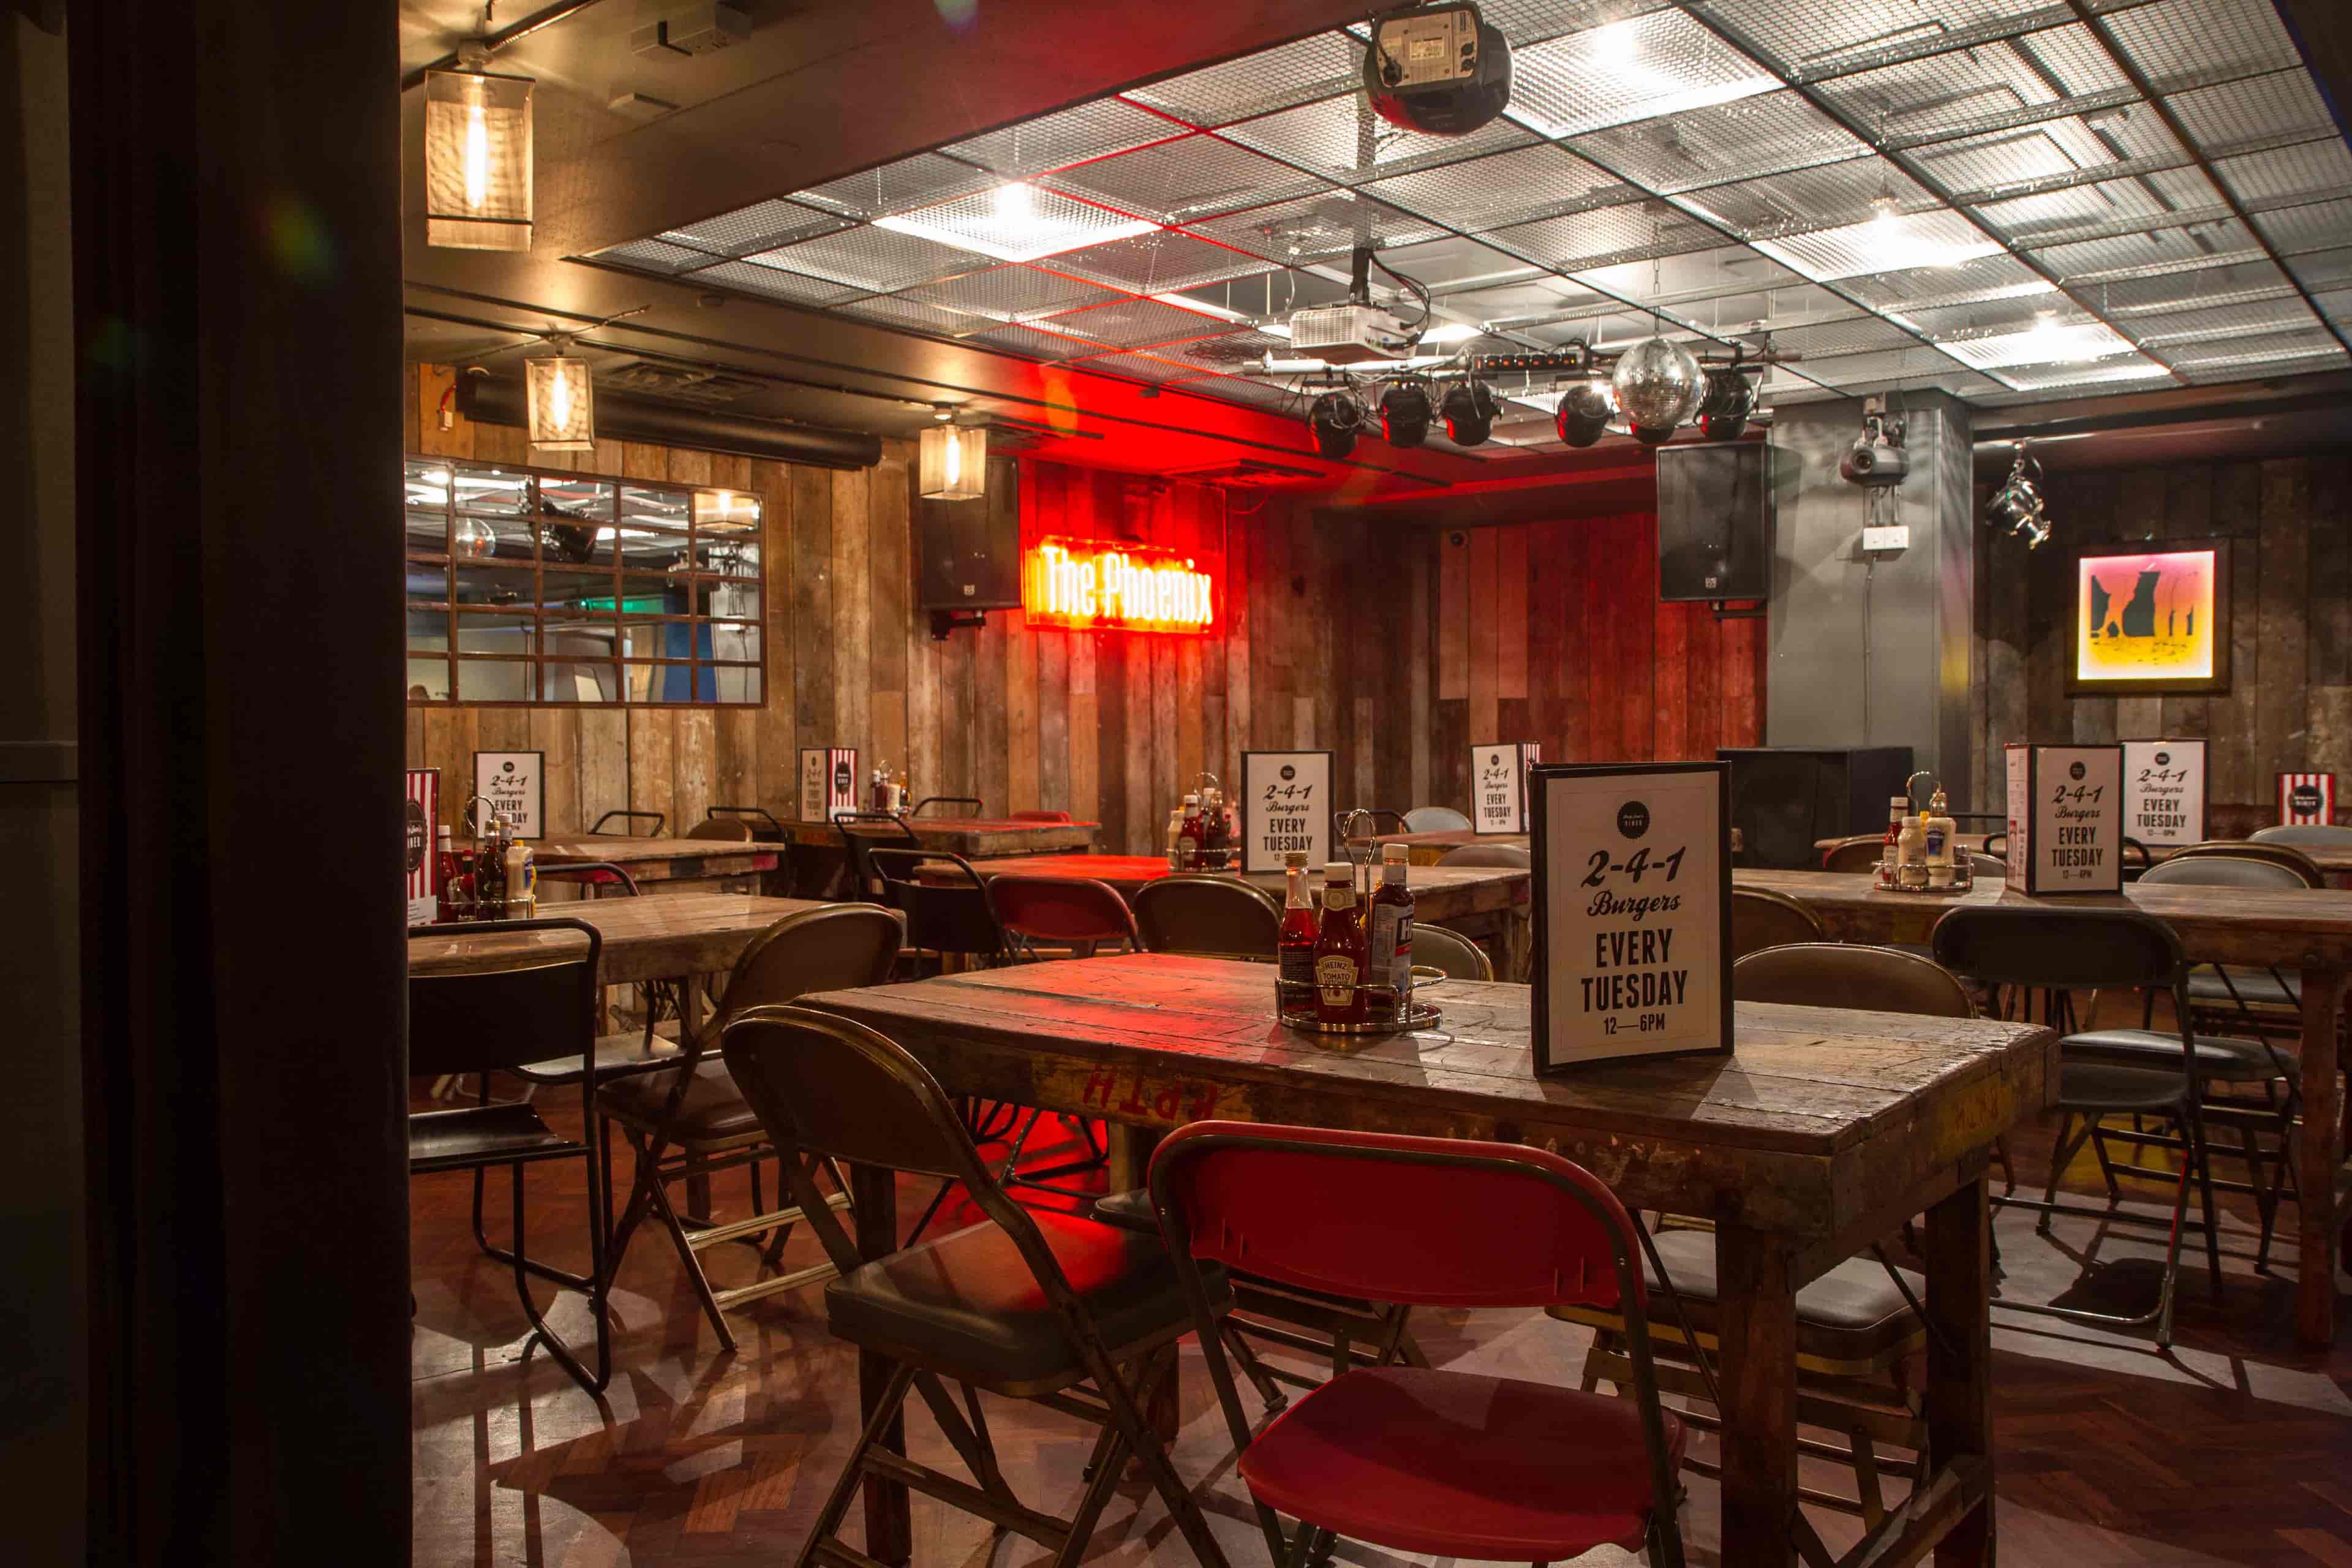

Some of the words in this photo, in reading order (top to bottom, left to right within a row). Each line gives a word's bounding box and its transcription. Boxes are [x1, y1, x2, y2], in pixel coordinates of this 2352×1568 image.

[1041, 545, 1095, 616] The
[1102, 552, 1213, 625] Phoenix
[490, 775, 528, 785] 2-4-1
[1483, 768, 1509, 780] 2-4-1
[2136, 769, 2188, 782] 2-4-1
[1263, 784, 1313, 799] 2-4-1
[2052, 785, 2104, 804] 2-4-1
[495, 800, 522, 810] EVERY
[1487, 794, 1506, 805] EVERY
[2144, 799, 2180, 812] EVERY
[1266, 801, 1310, 815] Burgers
[1483, 807, 1511, 818] TUESDAY
[2054, 805, 2101, 823] Burgers
[1270, 818, 1306, 833] EVERY
[2136, 814, 2187, 827] TUESDAY
[1264, 835, 1313, 851] TUESDAY
[2059, 826, 2097, 845] EVERY
[2052, 848, 2103, 867] TUESDAY
[1581, 846, 1686, 888] 2-4-1
[1587, 888, 1681, 921] Burgers
[1596, 929, 1673, 968] EVERY
[1324, 960, 1348, 970] HEINZ
[1581, 970, 1687, 1012] TUESDAY
